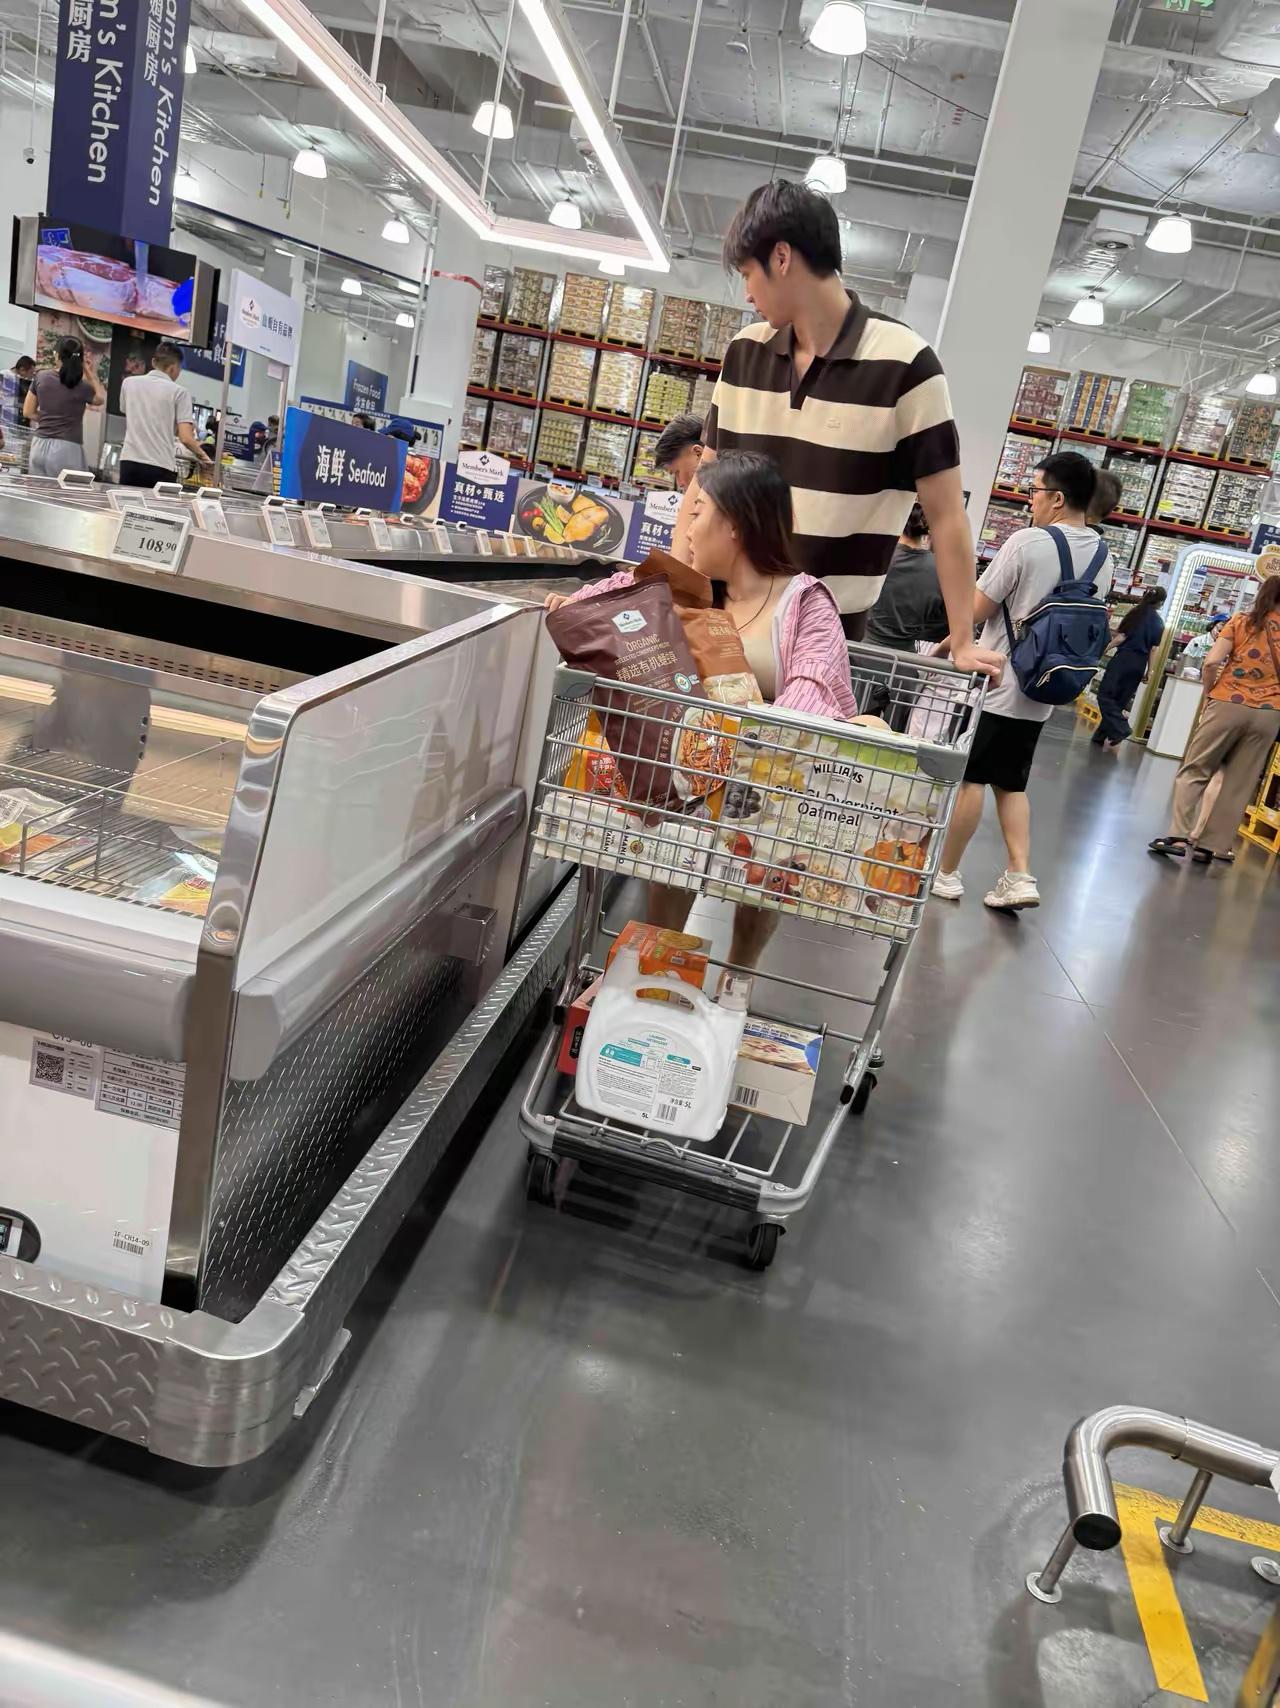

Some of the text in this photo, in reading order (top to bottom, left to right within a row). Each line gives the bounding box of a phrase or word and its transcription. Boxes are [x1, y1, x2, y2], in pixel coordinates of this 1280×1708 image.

[87, 57, 124, 184] Kitchen
[149, 85, 174, 206] Kitchen
[315, 444, 387, 488] 海鲜 Seafood
[462, 462, 504, 476] Member's Mark
[625, 633, 661, 652] ORGANIC
[813, 763, 864, 784] WILLIAMS
[797, 802, 860, 827] Oatmeal
